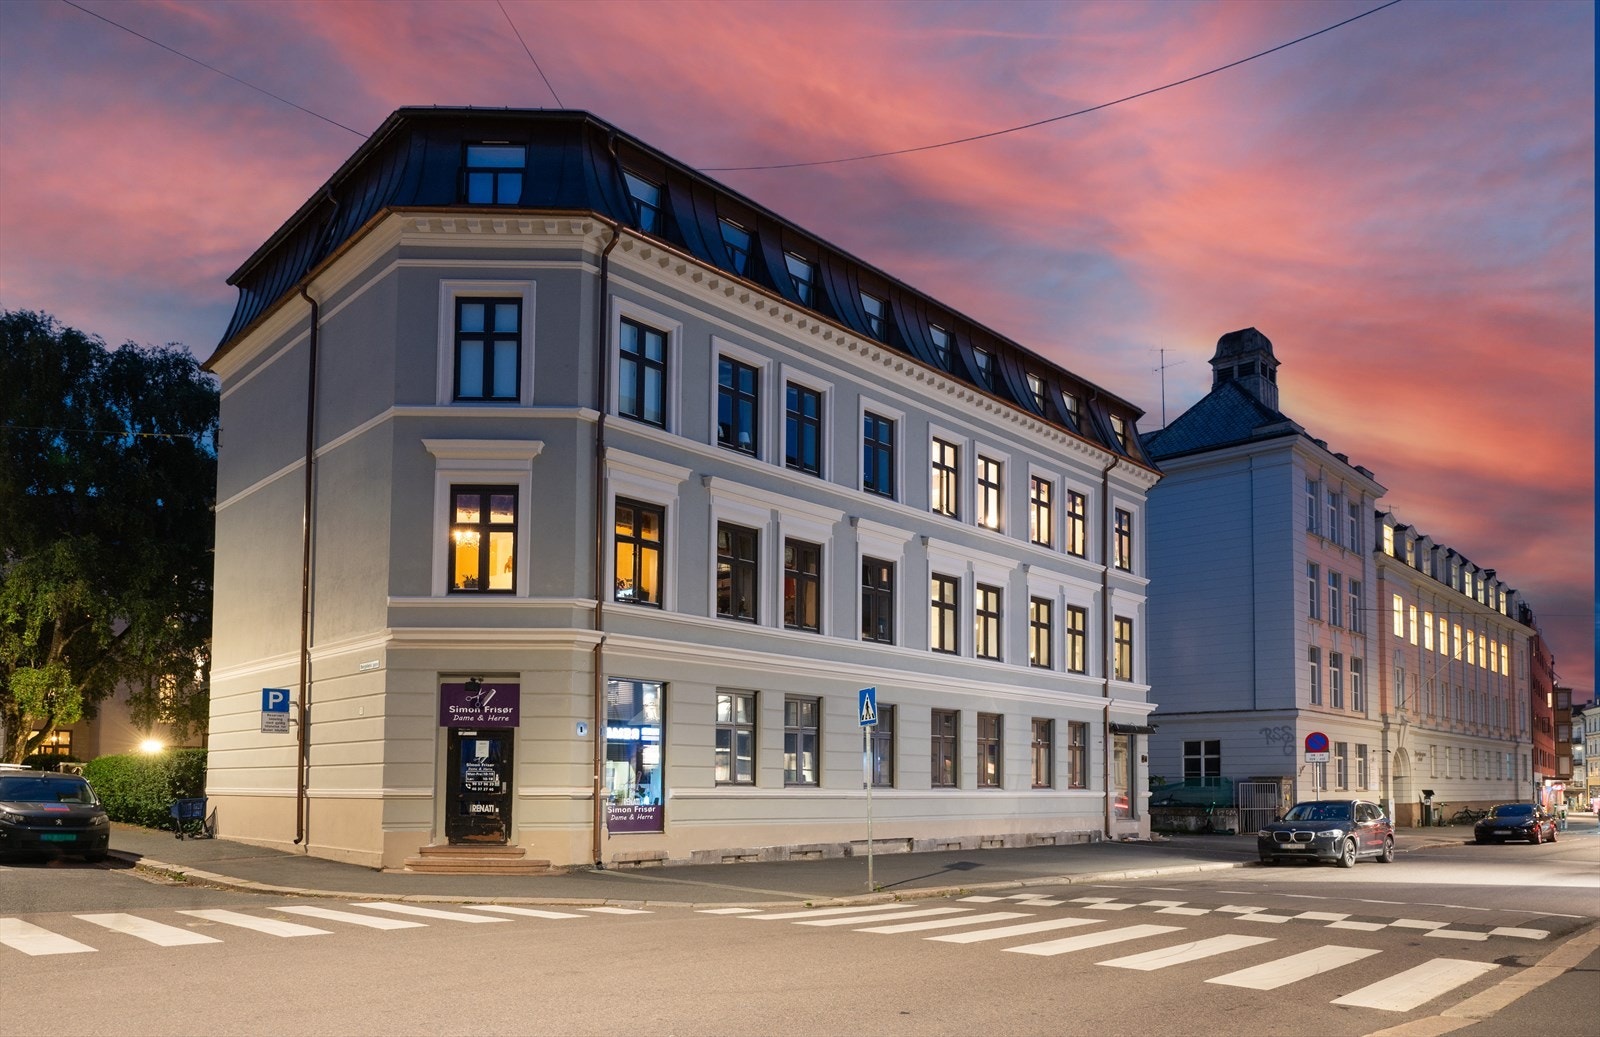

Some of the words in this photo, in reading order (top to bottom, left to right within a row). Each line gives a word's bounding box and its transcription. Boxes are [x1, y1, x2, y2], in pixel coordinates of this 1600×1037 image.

[268, 691, 283, 710] P
[449, 705, 481, 713] Simon
[484, 705, 513, 713] Frisør
[607, 806, 632, 814] Simon
[634, 805, 656, 813] Frisør
